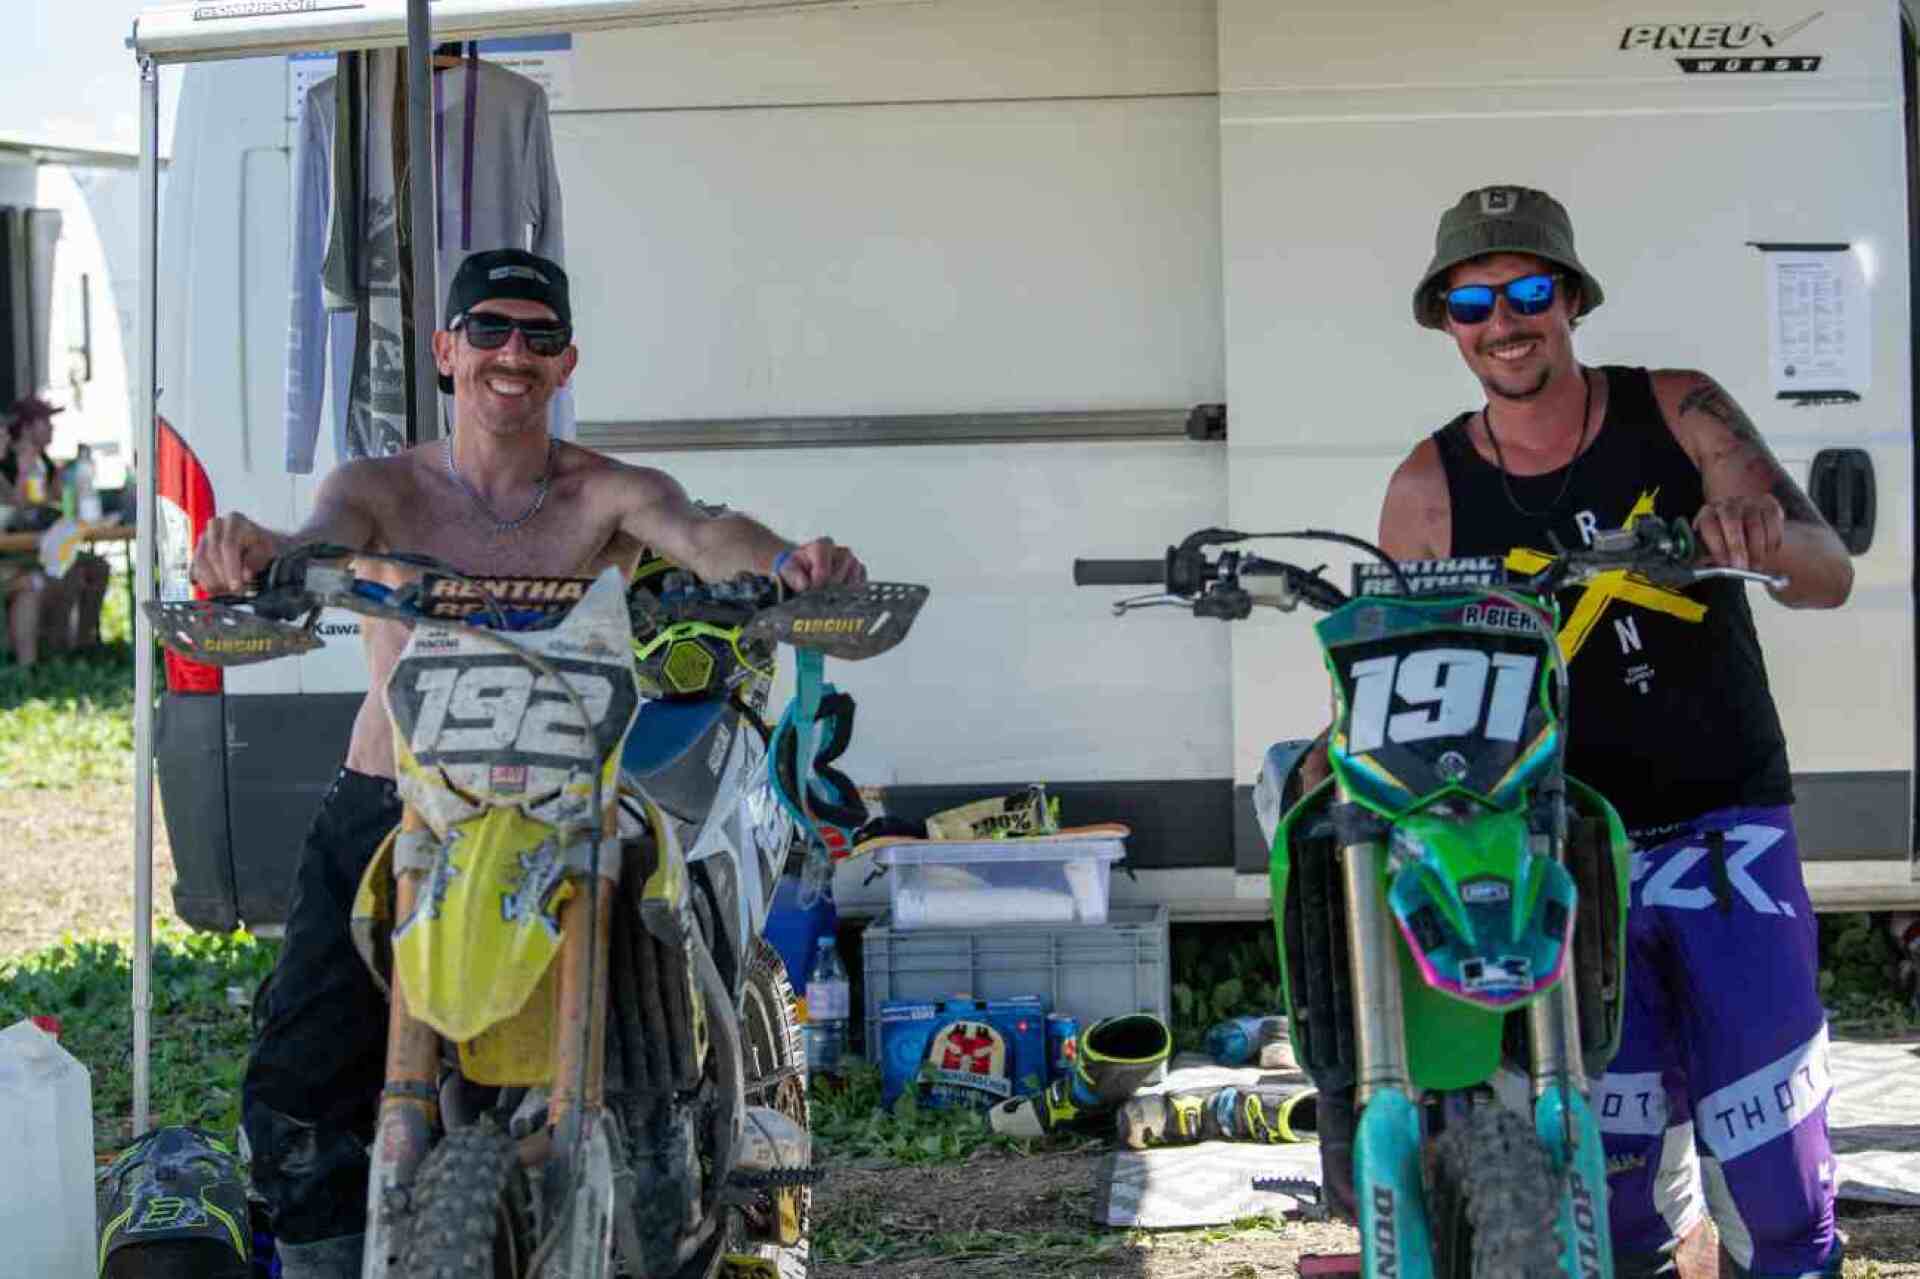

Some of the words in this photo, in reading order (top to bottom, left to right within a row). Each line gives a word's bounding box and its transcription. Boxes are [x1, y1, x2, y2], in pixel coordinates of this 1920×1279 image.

[792, 617, 865, 633] CIRCUIT
[412, 664, 613, 759] 192
[1349, 649, 1538, 754] 191
